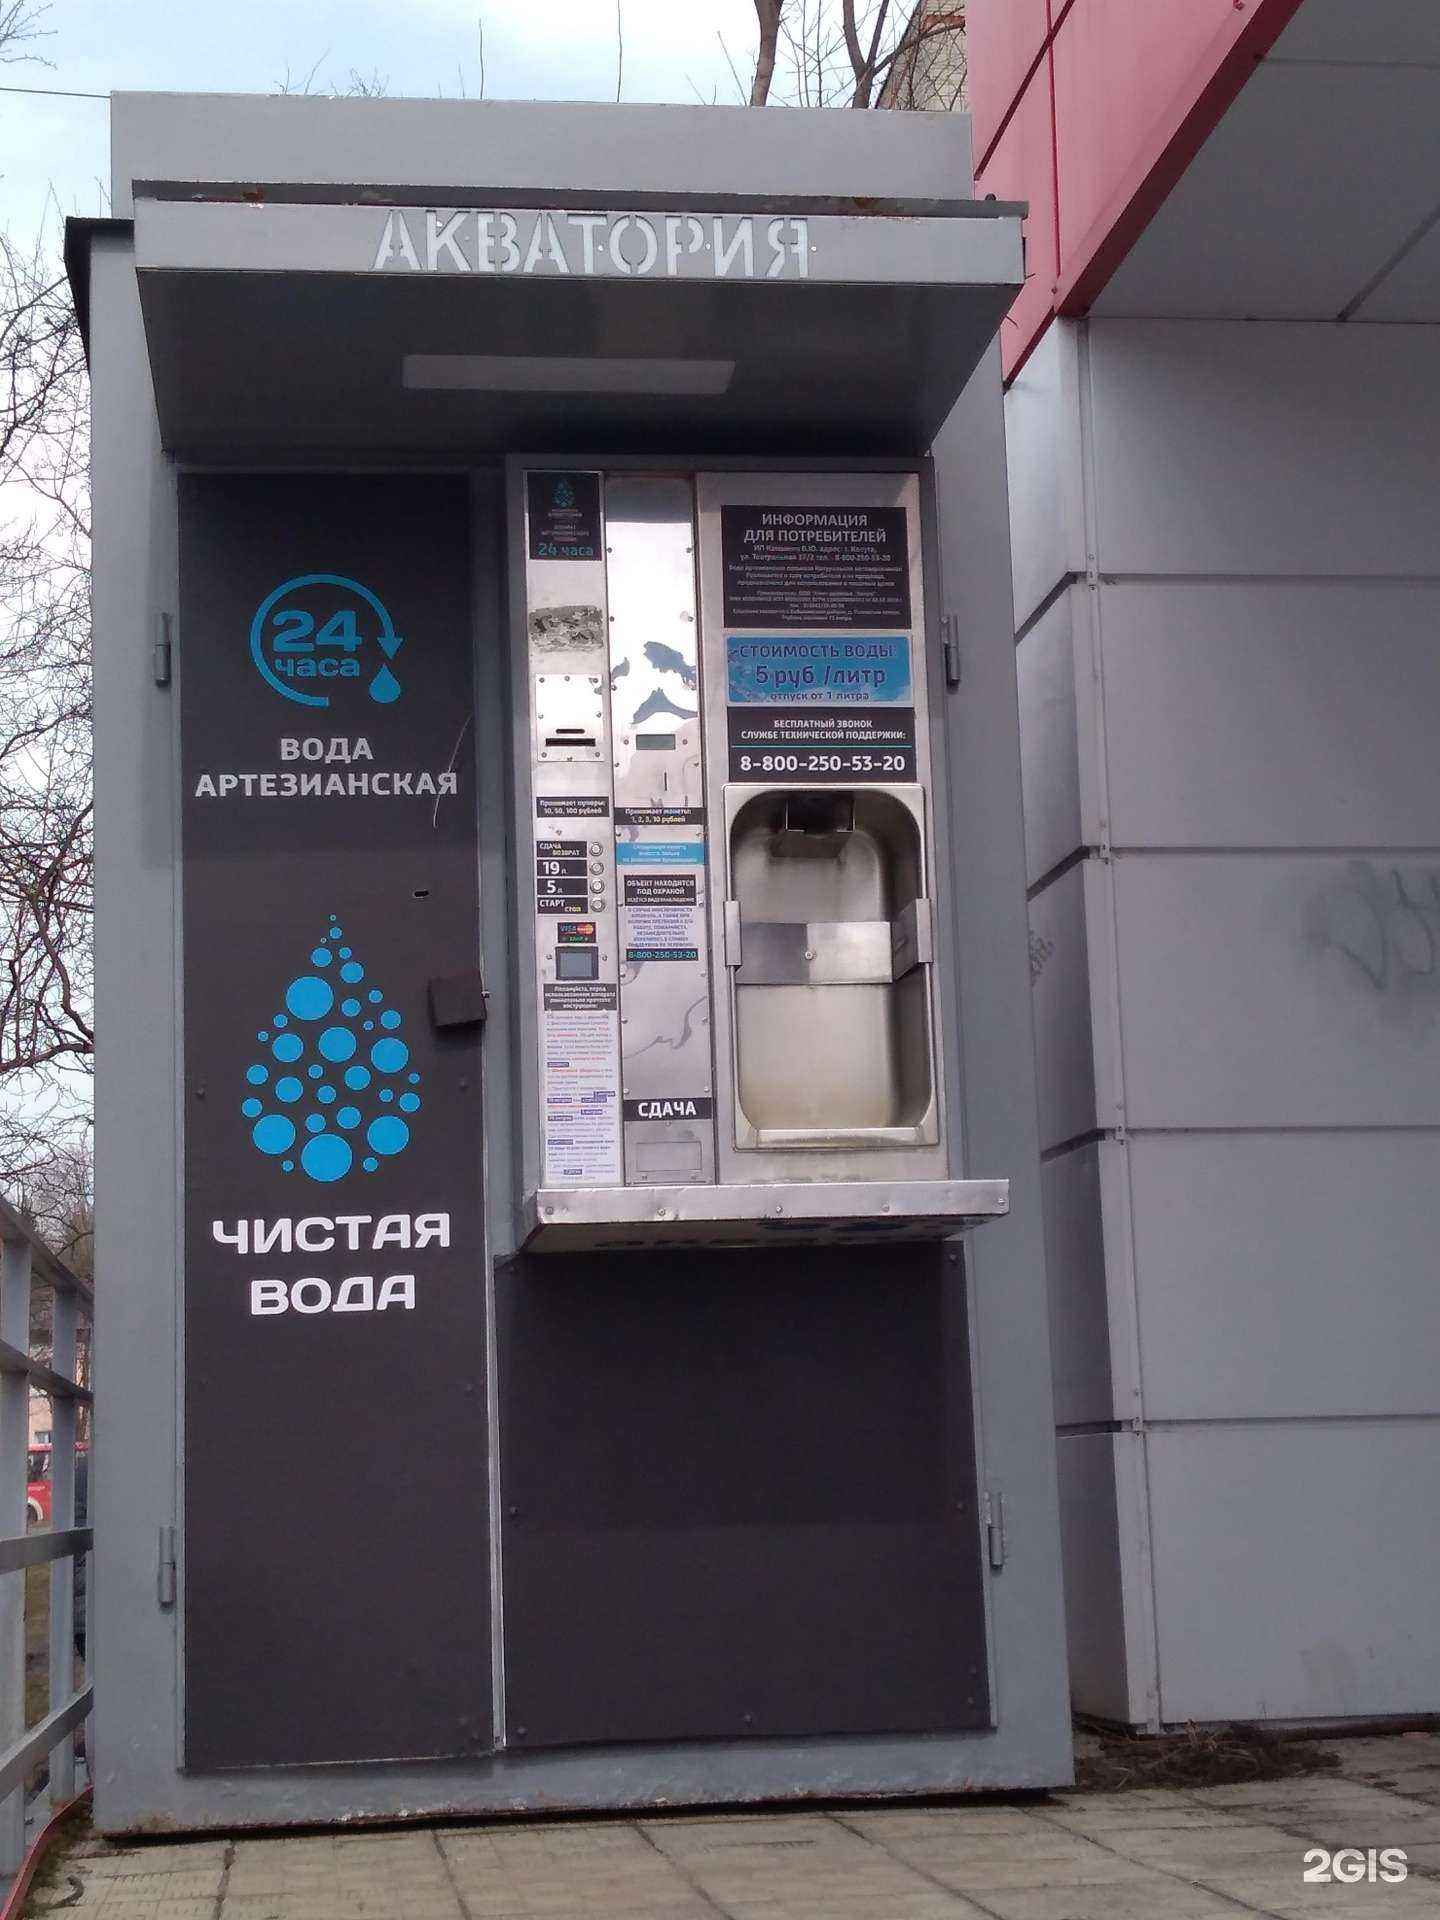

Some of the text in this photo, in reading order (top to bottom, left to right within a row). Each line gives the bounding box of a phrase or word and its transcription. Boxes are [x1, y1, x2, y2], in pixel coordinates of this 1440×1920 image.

[371, 208, 810, 280] АКВАТОРИЯ
[761, 513, 868, 528] ИНФОРМАЦИЯ
[743, 527, 887, 544] ДЛЯ ПОТРЕБИТЕЛЕЙ
[537, 543, 594, 557] 24 часа
[272, 609, 363, 653] 24
[739, 643, 893, 658] СТОИМОСТЬ ВОДЫ
[273, 656, 361, 678] часа
[755, 665, 769, 685] 5
[774, 665, 815, 688] руб
[769, 691, 870, 702] отпуск от 1 литра
[773, 718, 873, 729] БЕСПЛАТНЫЙ ЗВОНОК
[740, 729, 906, 741] СЛУЖБЕ ТЕХНИЧЕСКОЙ ПОДДЕРЖКИ:
[279, 736, 374, 764] ВОДА
[739, 755, 906, 772] 8-800-250-53-20
[194, 771, 458, 798] АРТЕЗИАНСКАЯ
[542, 861, 560, 875] 19
[546, 880, 557, 894] 5
[653, 887, 685, 895] ОХРАНОЙ
[539, 899, 566, 907] СТАРТ
[637, 1100, 698, 1119] СДАЧА
[211, 1212, 452, 1255] ЧИСТАЯ
[250, 1274, 417, 1316] ВОДА
